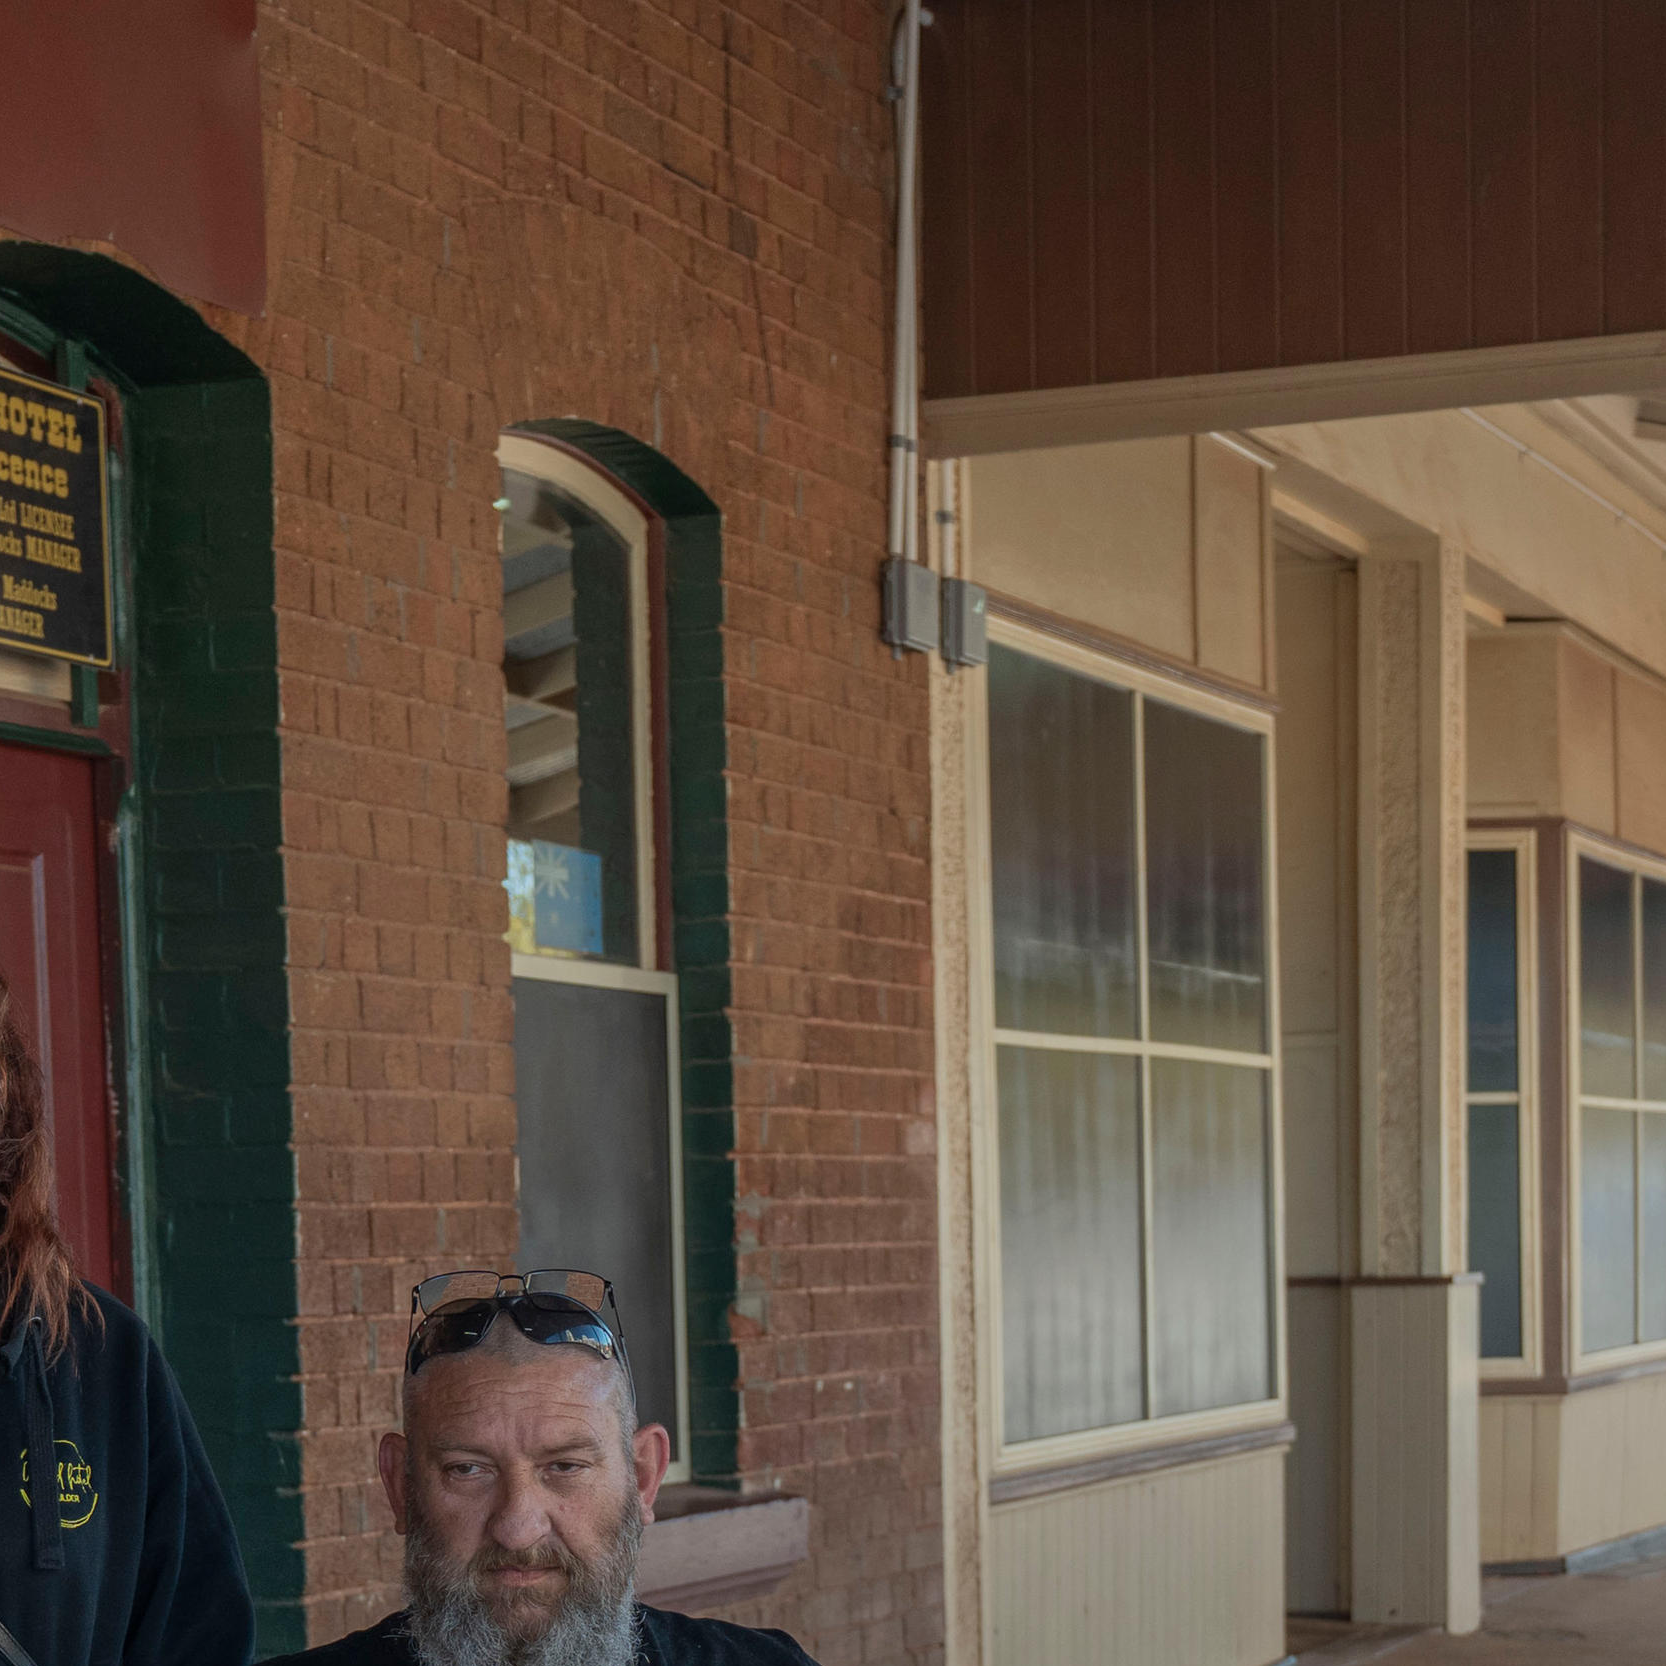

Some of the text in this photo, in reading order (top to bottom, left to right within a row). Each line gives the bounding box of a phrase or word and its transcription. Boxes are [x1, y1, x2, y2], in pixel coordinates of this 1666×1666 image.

[20, 502, 76, 540] LICENSEE
[25, 534, 83, 574] MANAGER
[2, 574, 58, 612] Maddocks
